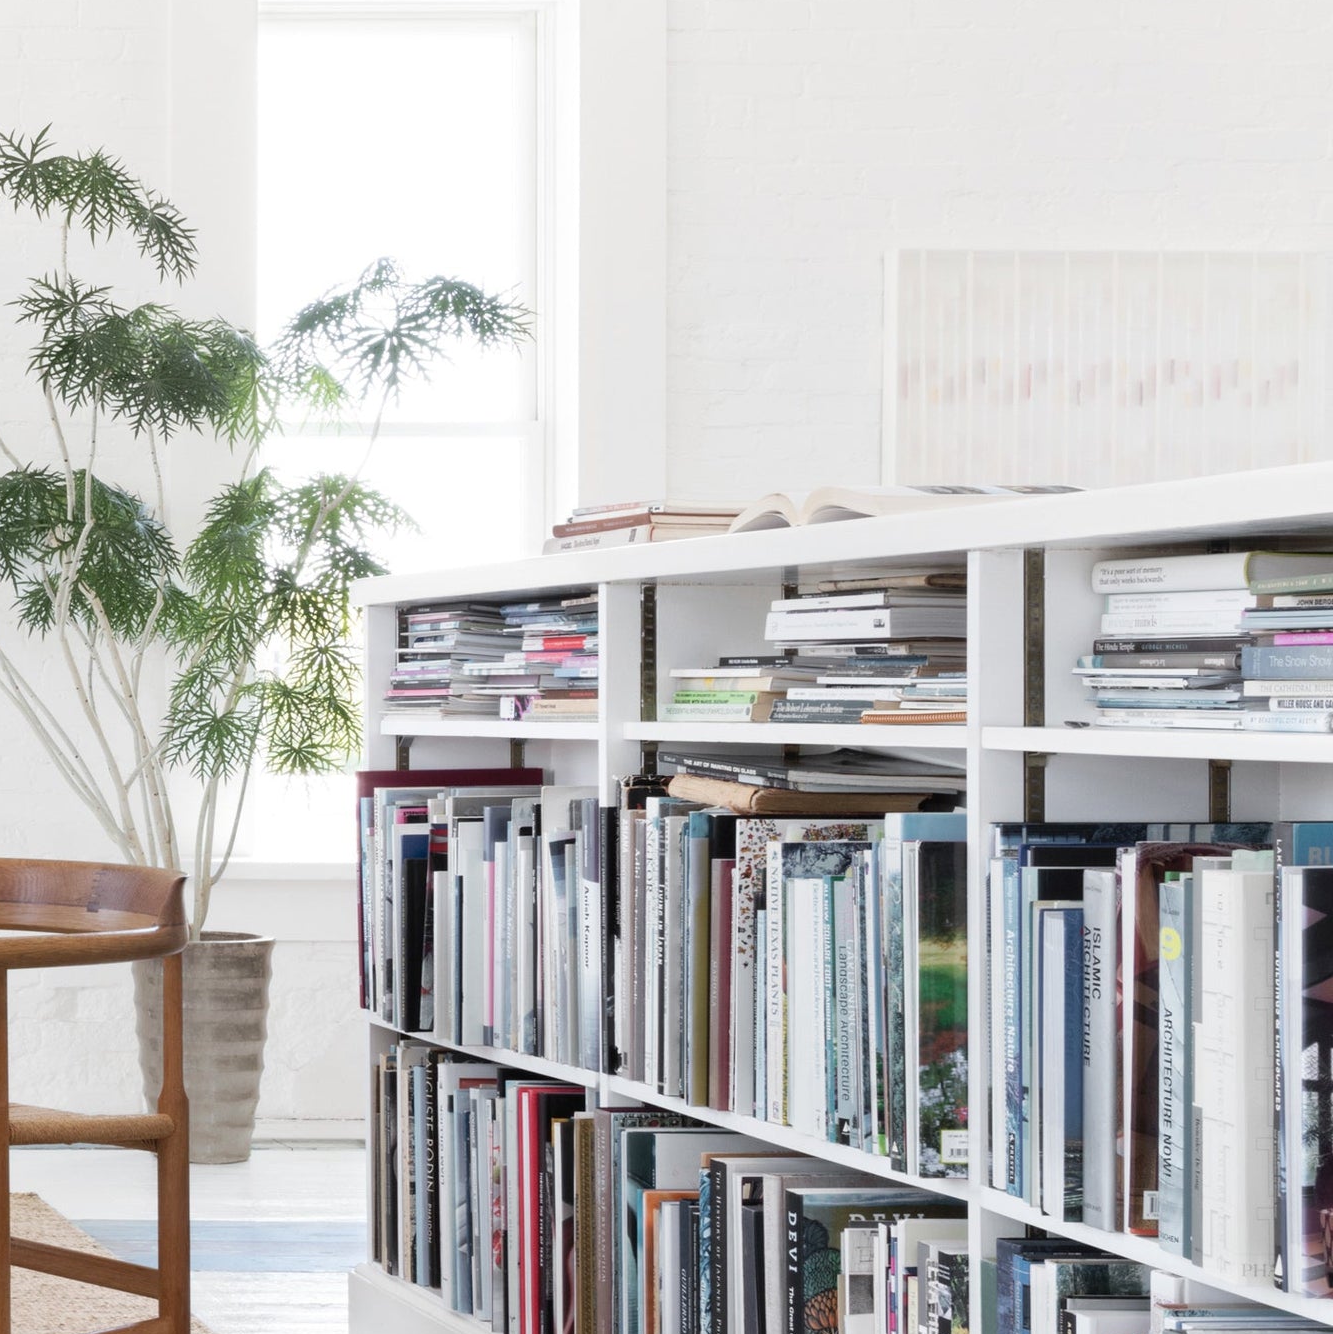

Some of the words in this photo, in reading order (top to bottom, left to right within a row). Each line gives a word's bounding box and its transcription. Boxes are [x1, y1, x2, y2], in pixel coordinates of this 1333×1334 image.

[1136, 566, 1143, 574] of
[1143, 567, 1163, 576] memory
[1104, 642, 1117, 651] Hindu
[1118, 643, 1135, 652] Temple
[1269, 656, 1284, 667] The
[1285, 655, 1307, 667] Snow
[1309, 655, 1331, 667] Show
[1274, 684, 1311, 692] CATHEDRAL
[1296, 700, 1312, 708] HOUSE
[1313, 700, 1324, 708] AND
[683, 758, 693, 766] THE
[693, 760, 703, 768] ART
[710, 763, 732, 772] PAINTING
[741, 767, 757, 775] GLASS
[770, 866, 779, 914] NATIVE
[770, 920, 779, 960] TEXAS
[824, 964, 832, 988] FOOT
[838, 945, 850, 1016] Landscape
[1092, 927, 1102, 1000] ISLAMIC
[770, 965, 779, 1015] PLANTS
[1083, 925, 1092, 1067] ARCHITECTURE
[1275, 1019, 1282, 1031] &
[840, 1020, 851, 1101] Architecture
[1005, 1024, 1016, 1072] Nature
[1163, 1007, 1174, 1128] ARCHITECTURE
[425, 1059, 434, 1132] AUGUSTE
[1275, 1035, 1283, 1111] LANDSCAPES
[426, 1139, 434, 1193] RODIN
[1163, 1133, 1173, 1178] NOW!
[787, 1211, 798, 1274] DEVI
[788, 1286, 796, 1304] The
[927, 1266, 938, 1311] EVA
[788, 1306, 796, 1331] Great
